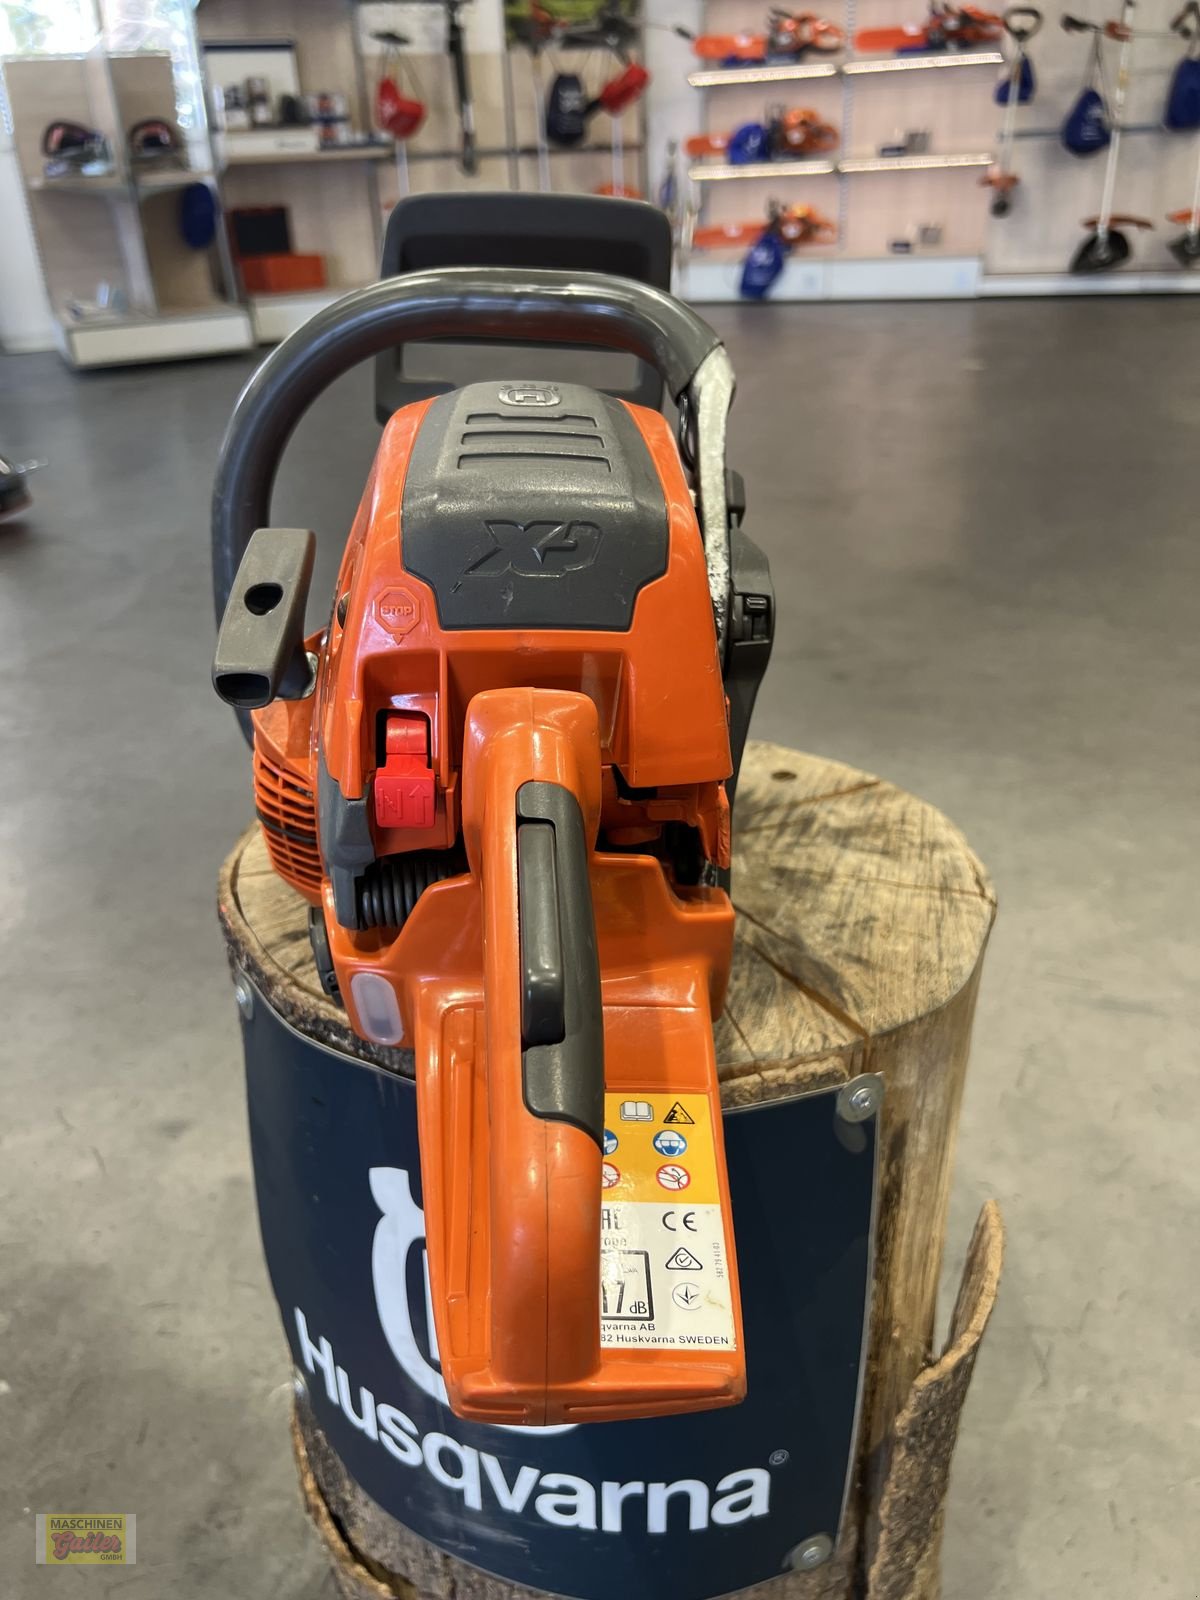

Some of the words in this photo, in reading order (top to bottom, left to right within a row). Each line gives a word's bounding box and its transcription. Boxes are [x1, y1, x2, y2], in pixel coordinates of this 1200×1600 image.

[381, 605, 413, 617] STOP
[661, 1211, 698, 1232] CE
[629, 1300, 647, 1314] dB
[601, 1323, 637, 1332] qvarna
[639, 1322, 656, 1331] AB
[616, 1334, 675, 1344] Huskvarna
[678, 1335, 729, 1345] SWEDEN
[294, 1307, 771, 1534] Husqvarna
